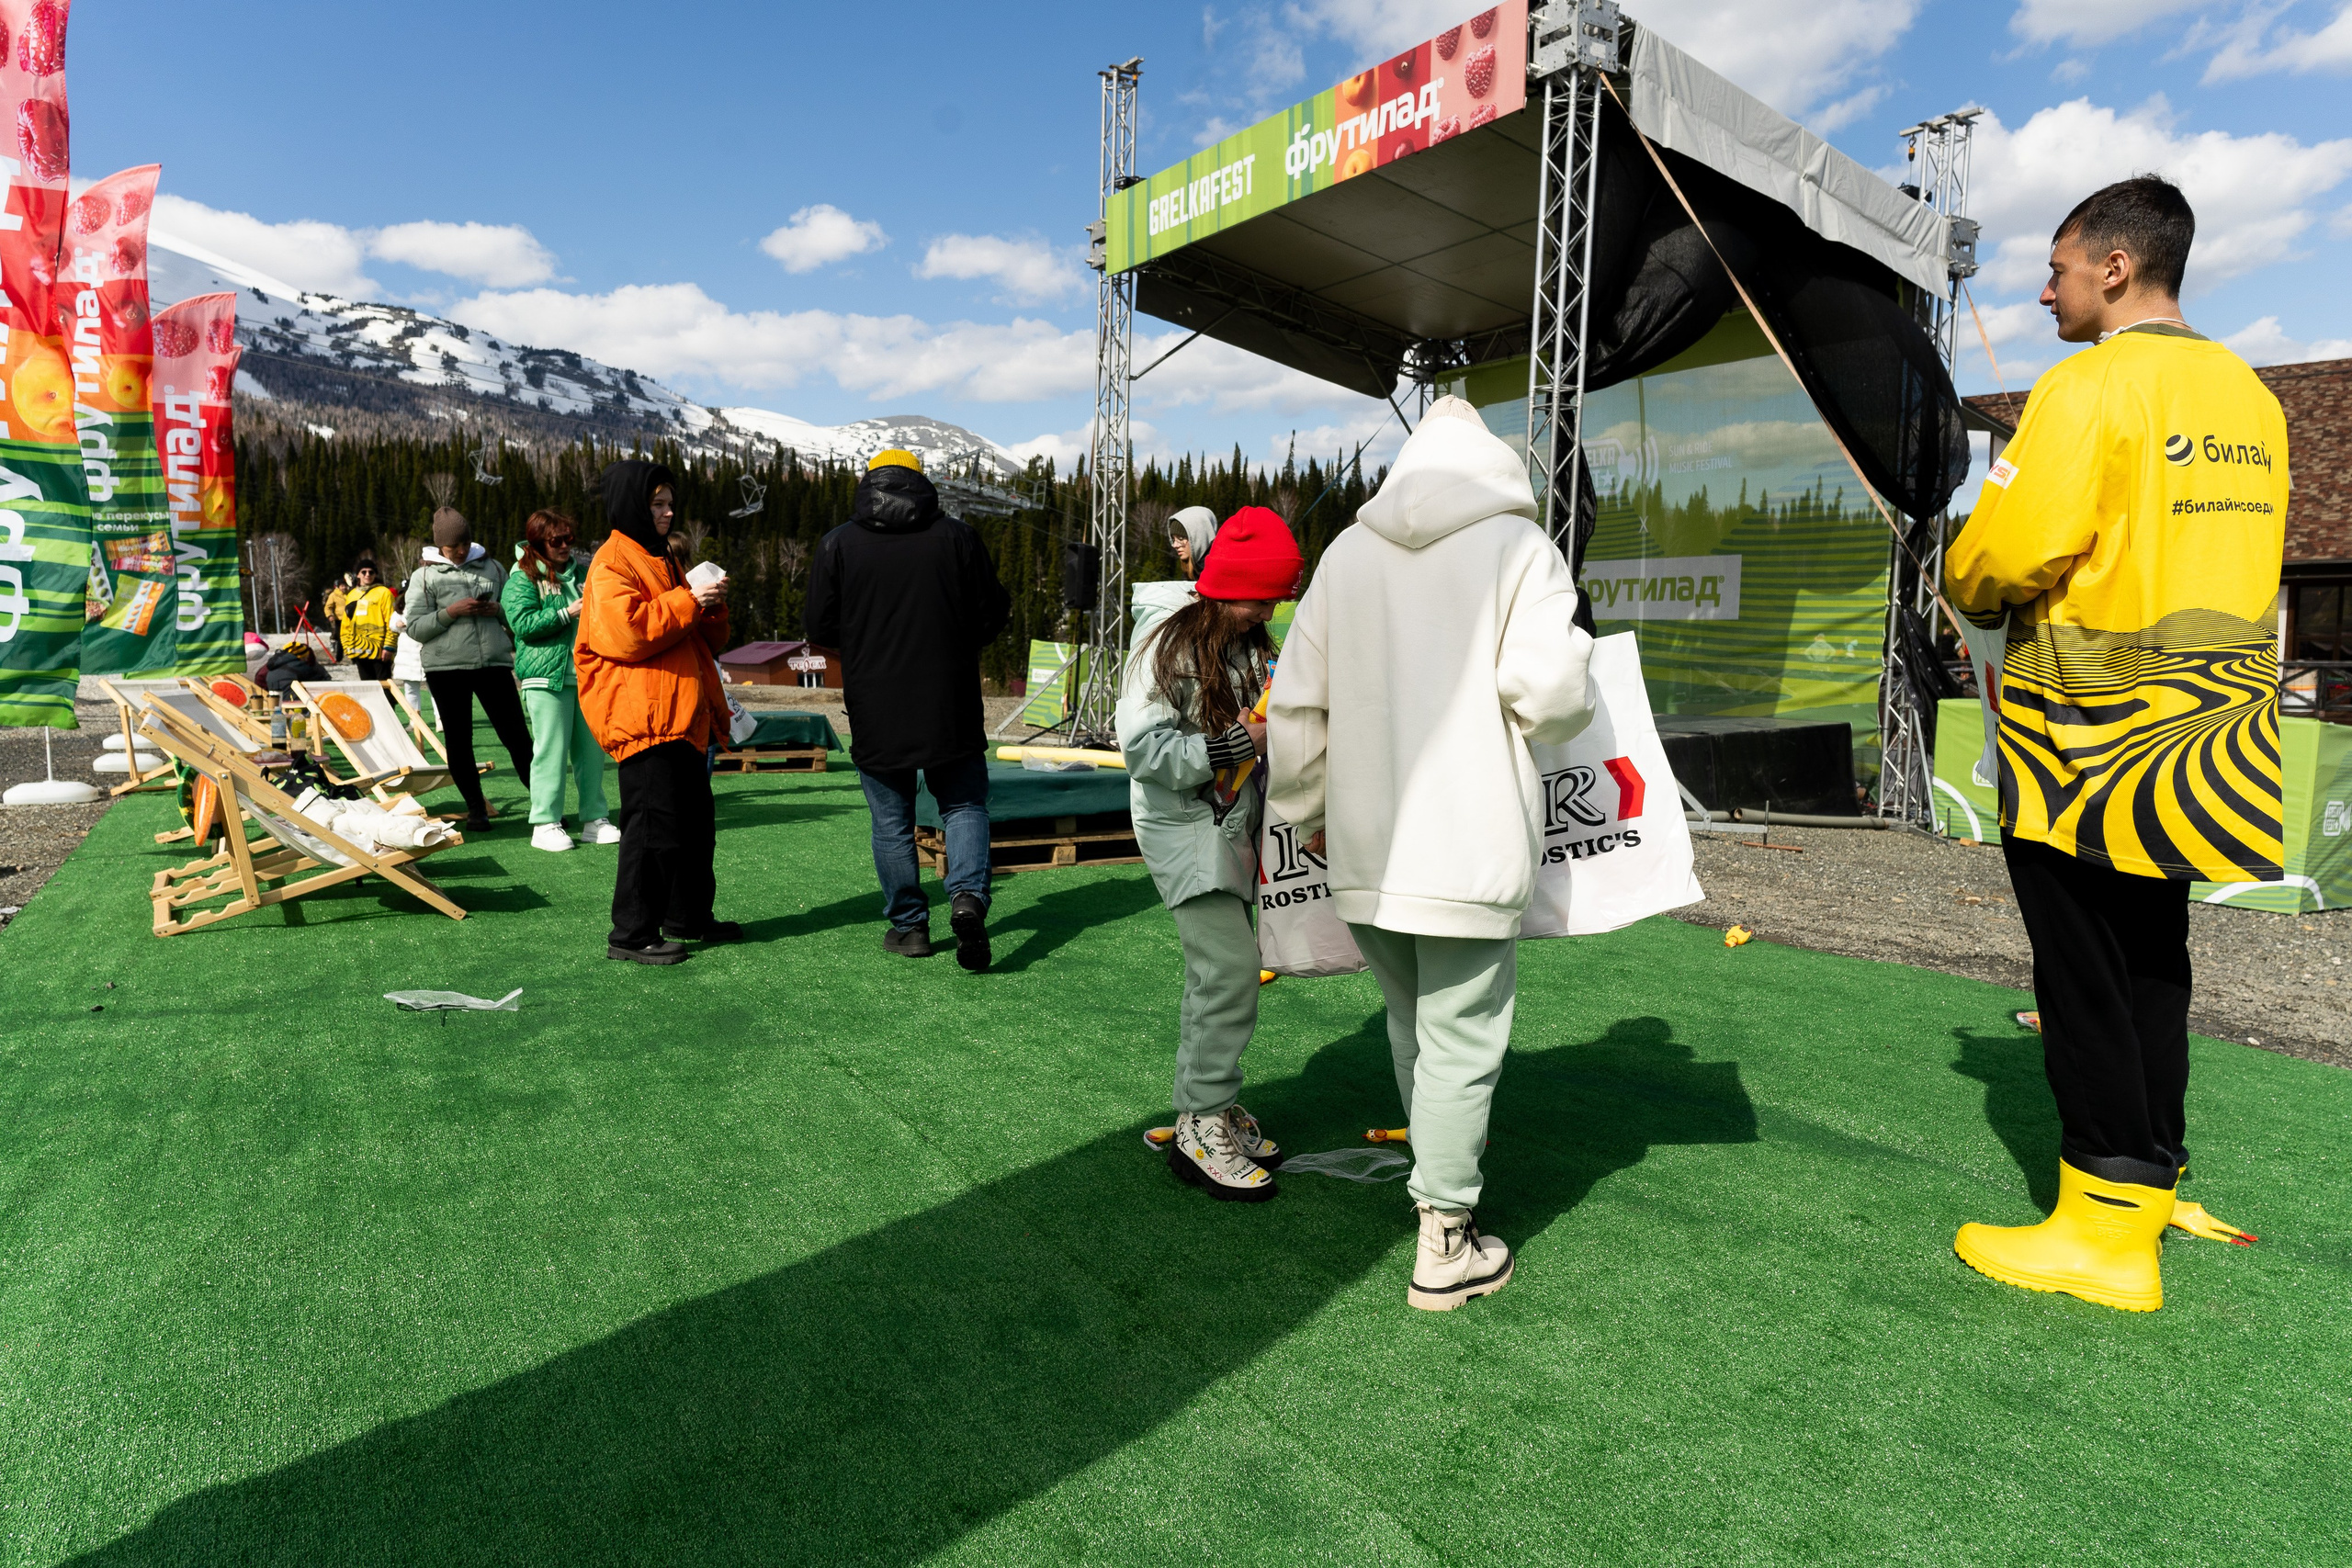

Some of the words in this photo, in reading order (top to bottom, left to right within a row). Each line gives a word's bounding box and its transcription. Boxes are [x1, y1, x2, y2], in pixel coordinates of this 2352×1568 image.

[1148, 153, 1255, 237] GRELKAFEST
[1668, 446, 1685, 457] SUN
[1694, 441, 1713, 454] RIDE
[1668, 461, 1694, 475] MUSIC
[1695, 457, 1733, 472] FESTIVAL
[1540, 829, 1642, 867] STIC'S
[1261, 882, 1333, 911] ROSTI
